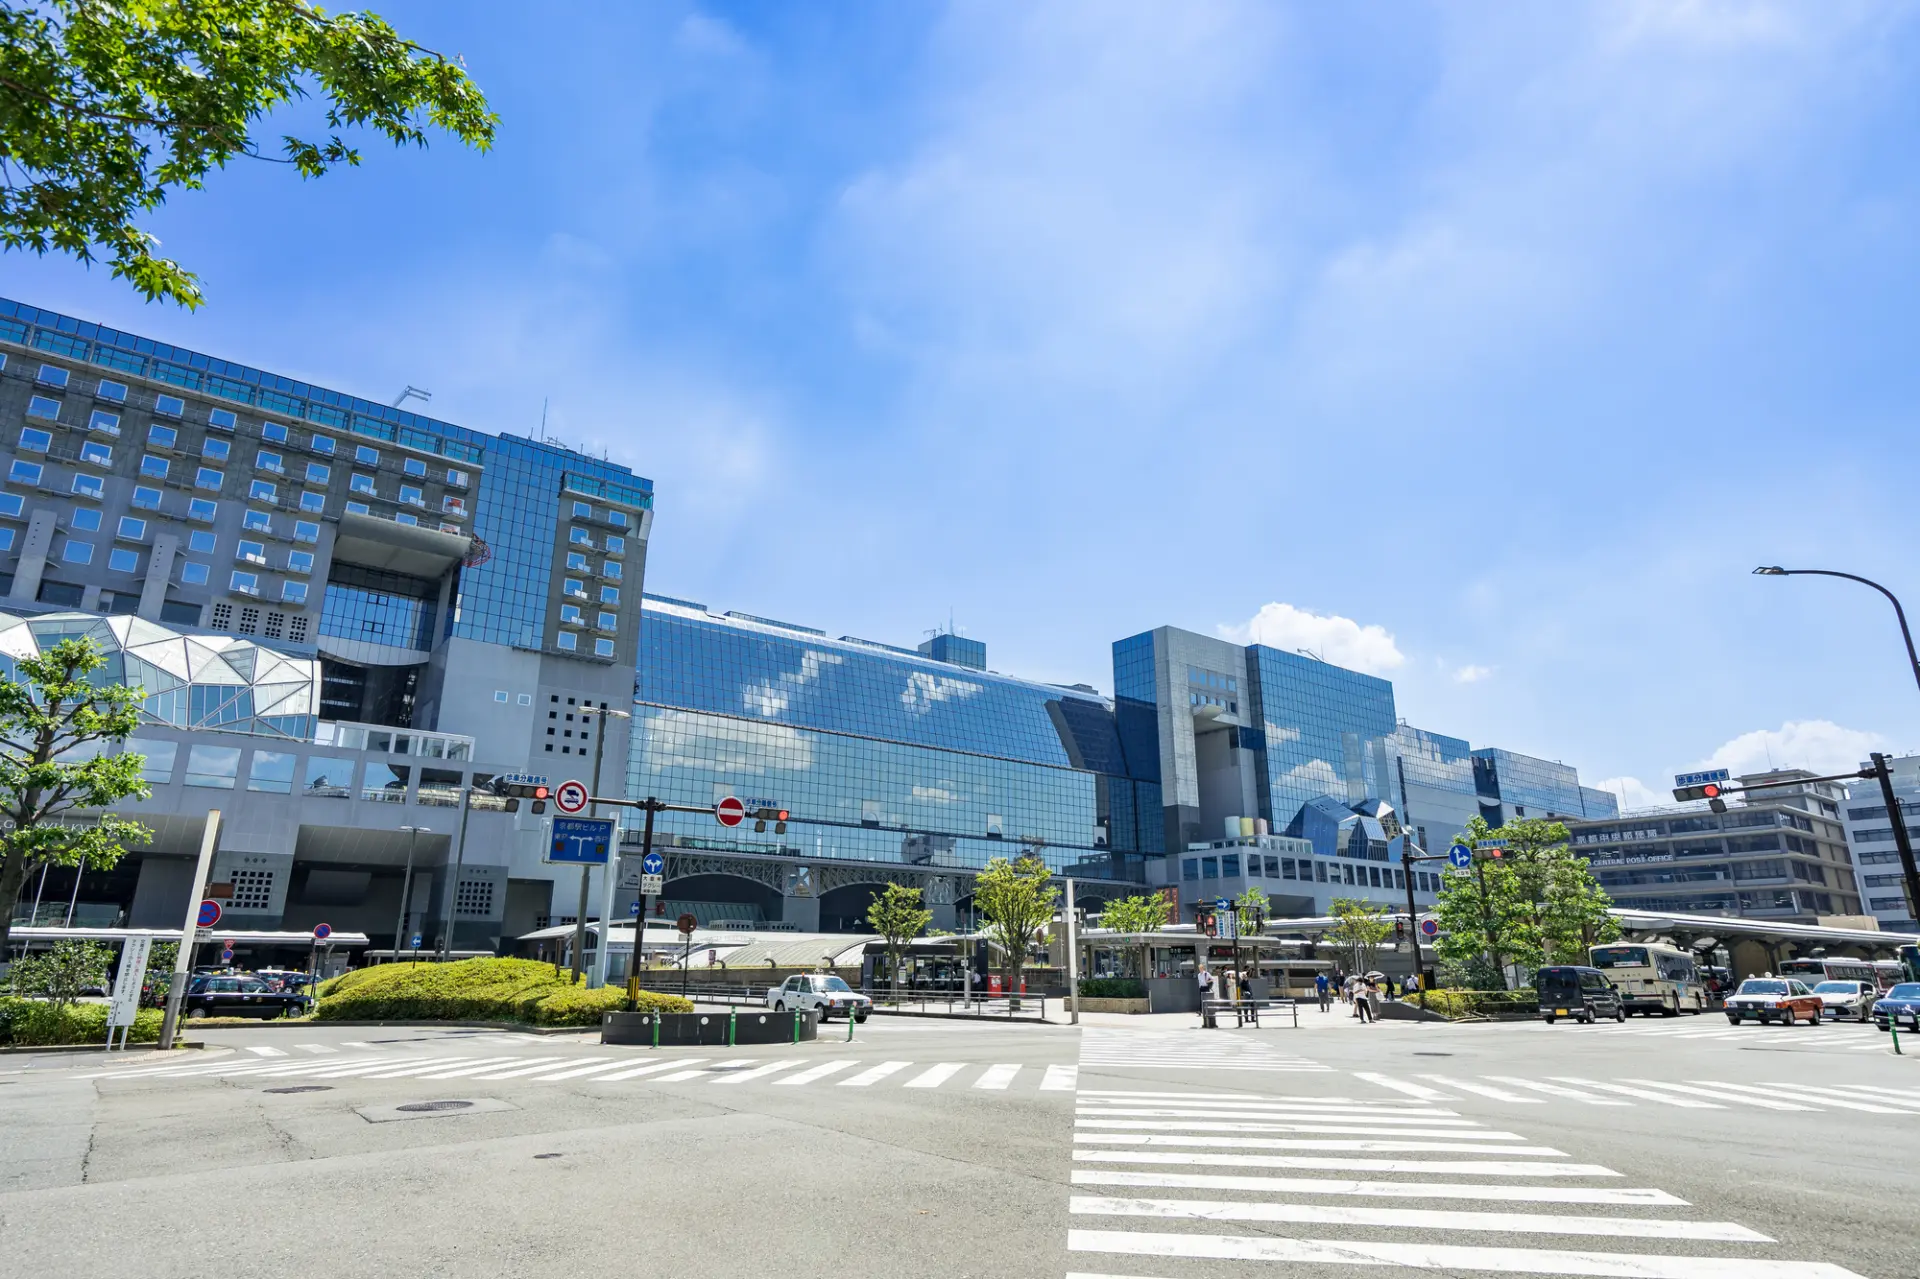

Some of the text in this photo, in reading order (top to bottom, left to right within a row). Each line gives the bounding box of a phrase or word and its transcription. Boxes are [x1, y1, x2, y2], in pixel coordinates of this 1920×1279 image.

[1677, 771, 1726, 784] 歩車分離信号
[1576, 829, 1657, 844] 京都中央郵便局
[1593, 857, 1625, 867] CENTRAL
[1626, 855, 1645, 864] POST
[1647, 853, 1674, 863] OFFICE
